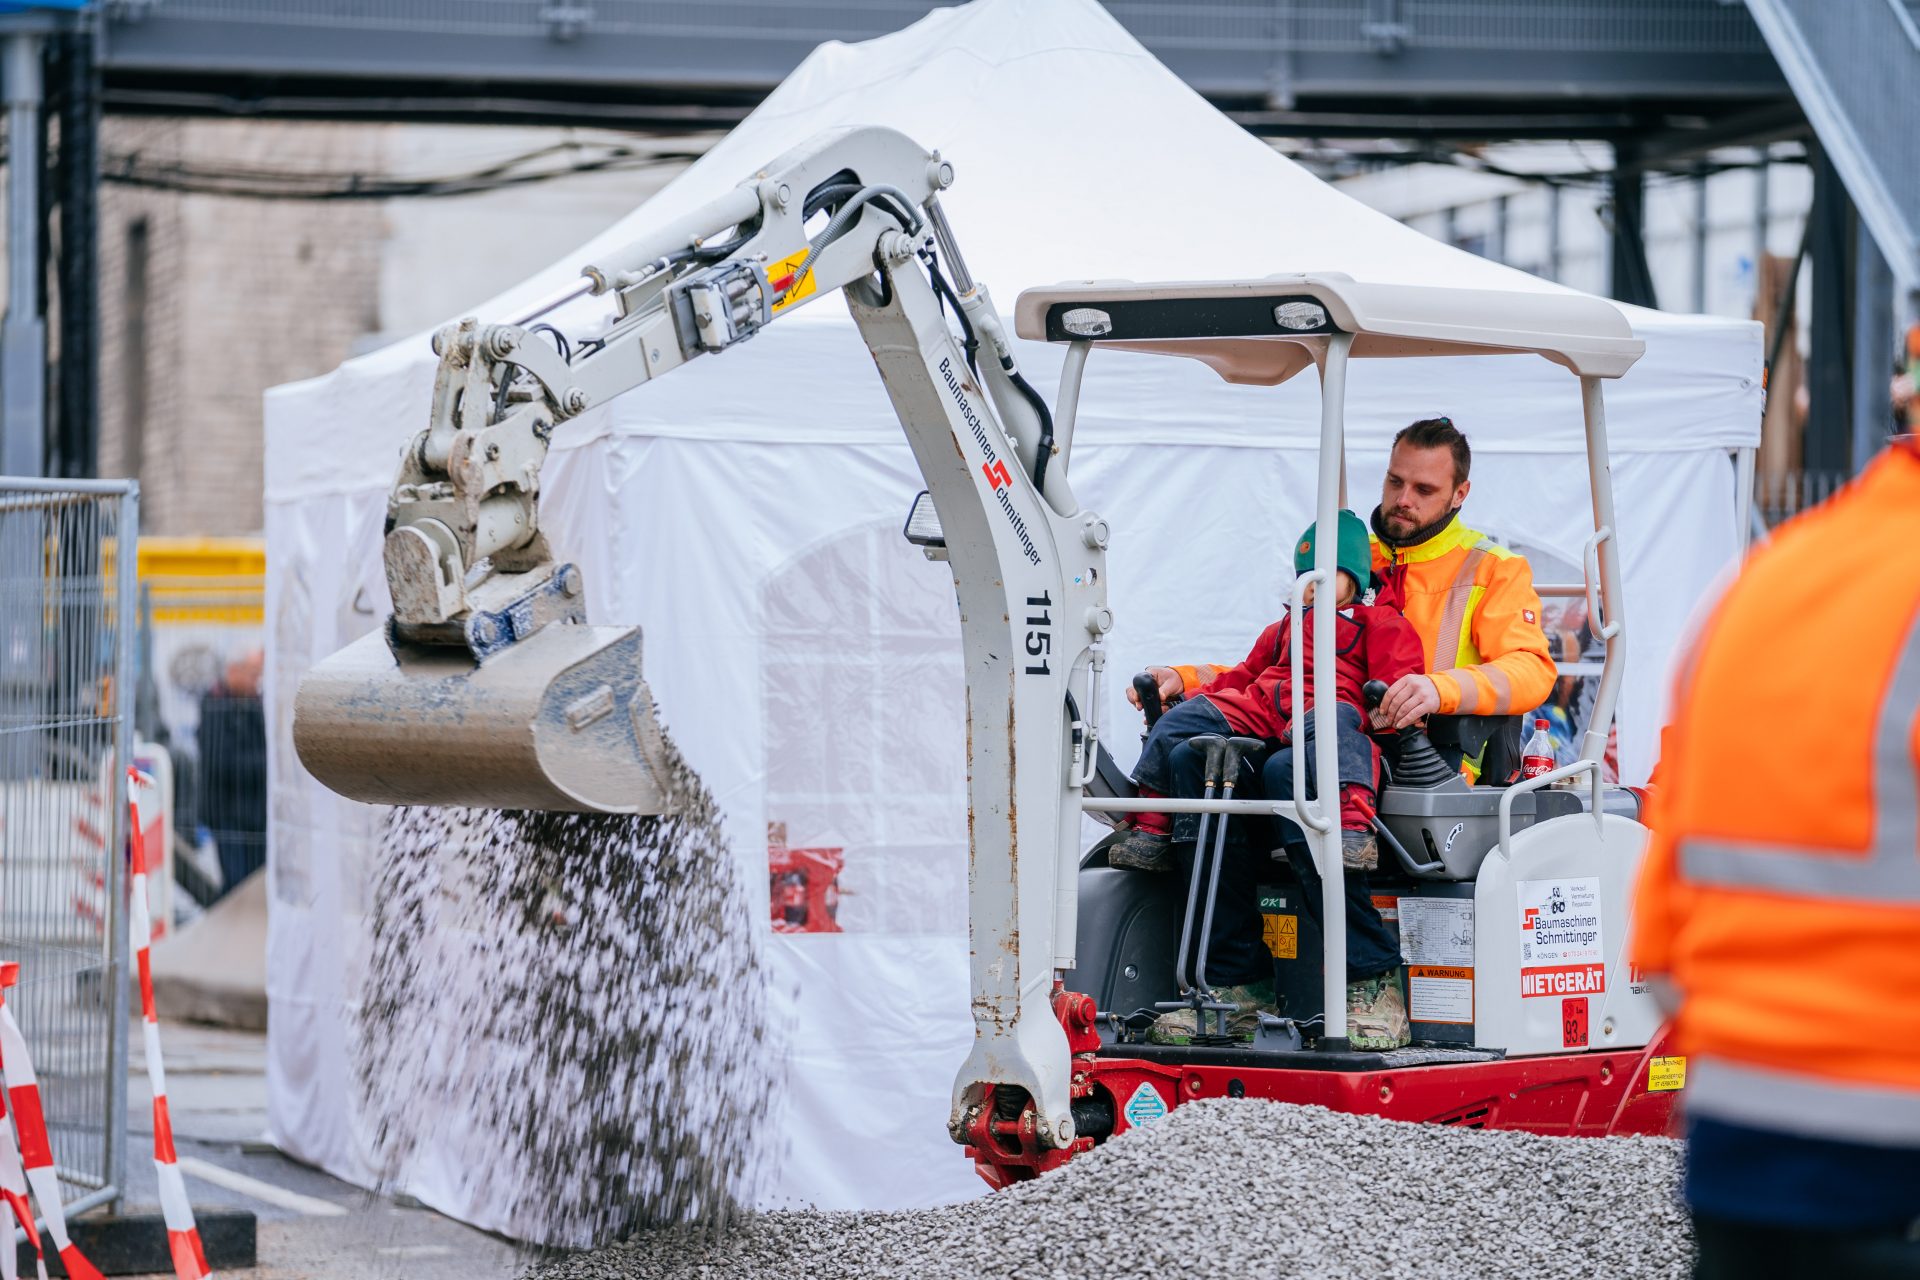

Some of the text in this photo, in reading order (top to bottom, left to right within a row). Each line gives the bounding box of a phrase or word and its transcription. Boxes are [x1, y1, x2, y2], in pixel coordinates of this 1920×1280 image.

[939, 357, 995, 464] Baumaschinen
[1025, 589, 1051, 675] 1151
[1260, 898, 1279, 907] OK
[1535, 915, 1597, 930] Baumaschinen
[1536, 929, 1597, 945] Schmittinger
[1537, 951, 1558, 960] KÖNGEN
[1427, 969, 1466, 978] WARNUNG
[1522, 967, 1603, 995] MIETGERÄT
[1565, 1020, 1578, 1043] 93
